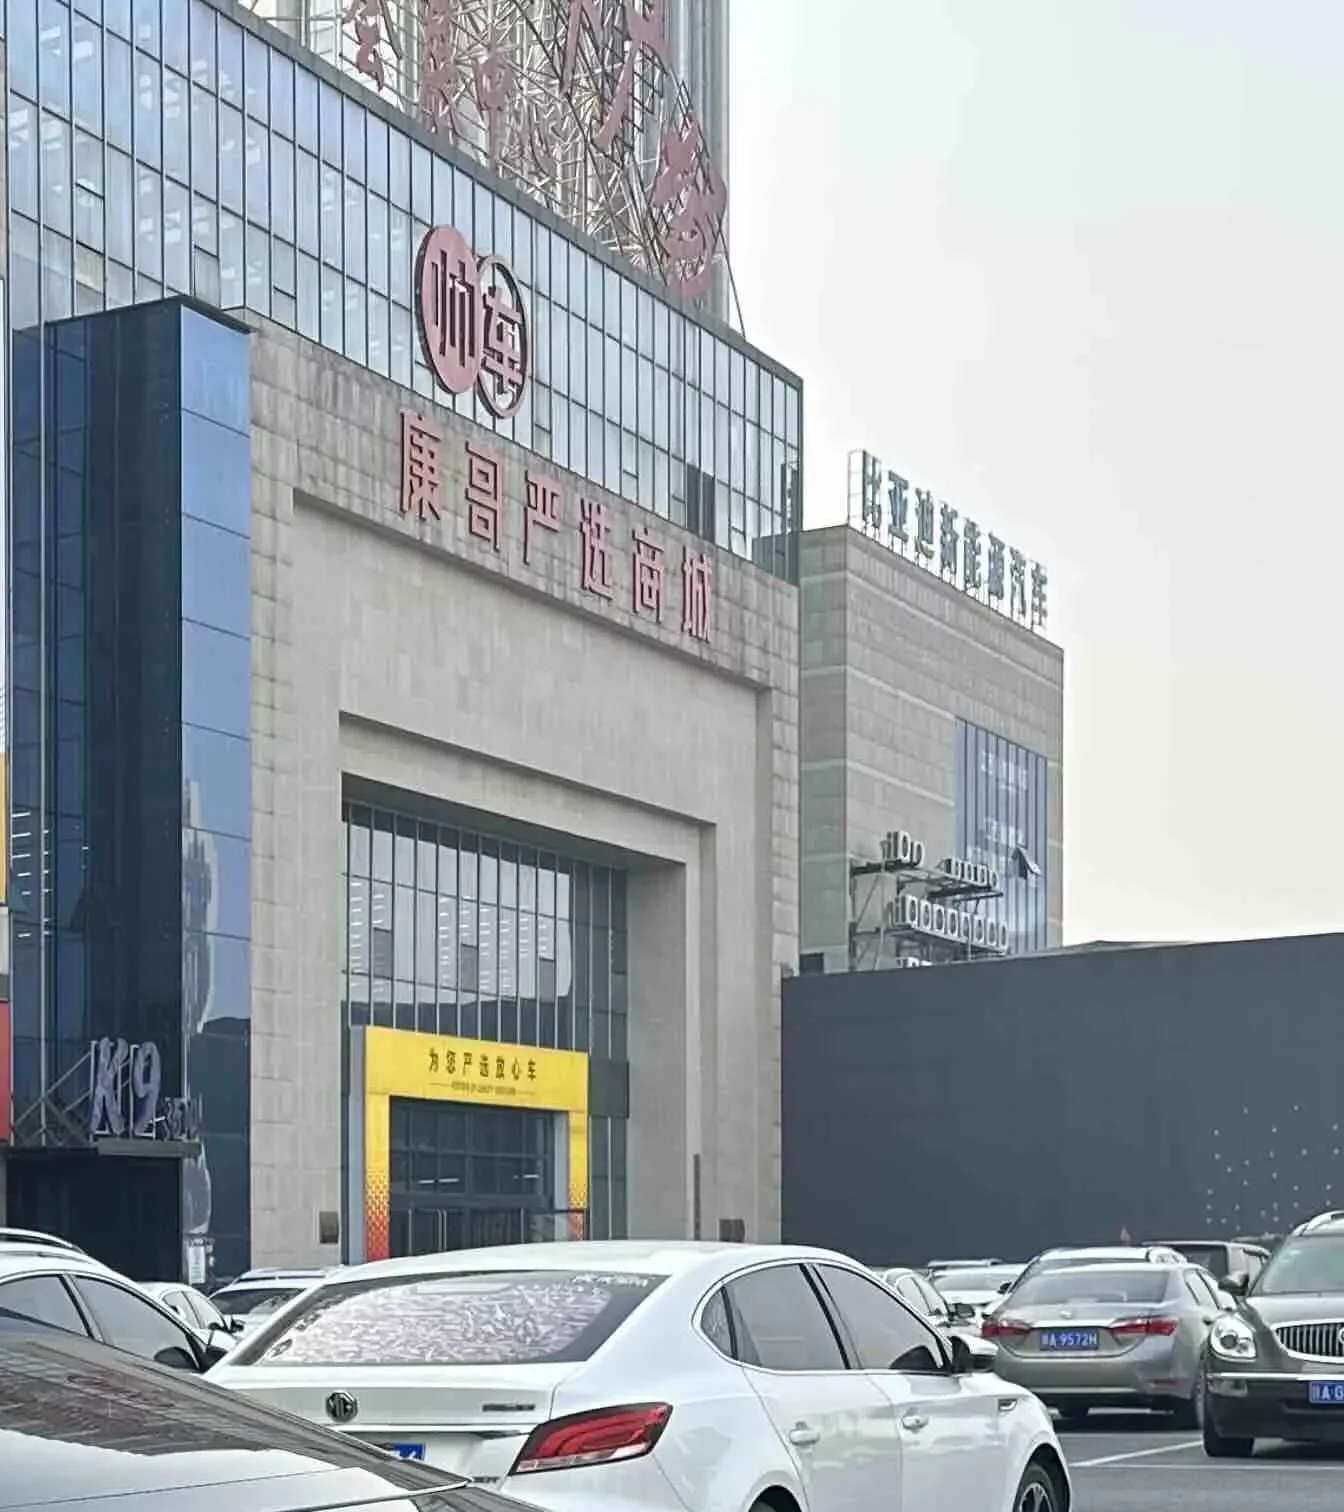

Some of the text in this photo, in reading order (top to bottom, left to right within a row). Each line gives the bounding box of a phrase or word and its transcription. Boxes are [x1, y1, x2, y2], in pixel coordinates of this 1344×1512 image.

[400, 409, 712, 644] 康哥严选商城
[863, 450, 1048, 626] 比亚迪新能源汽车
